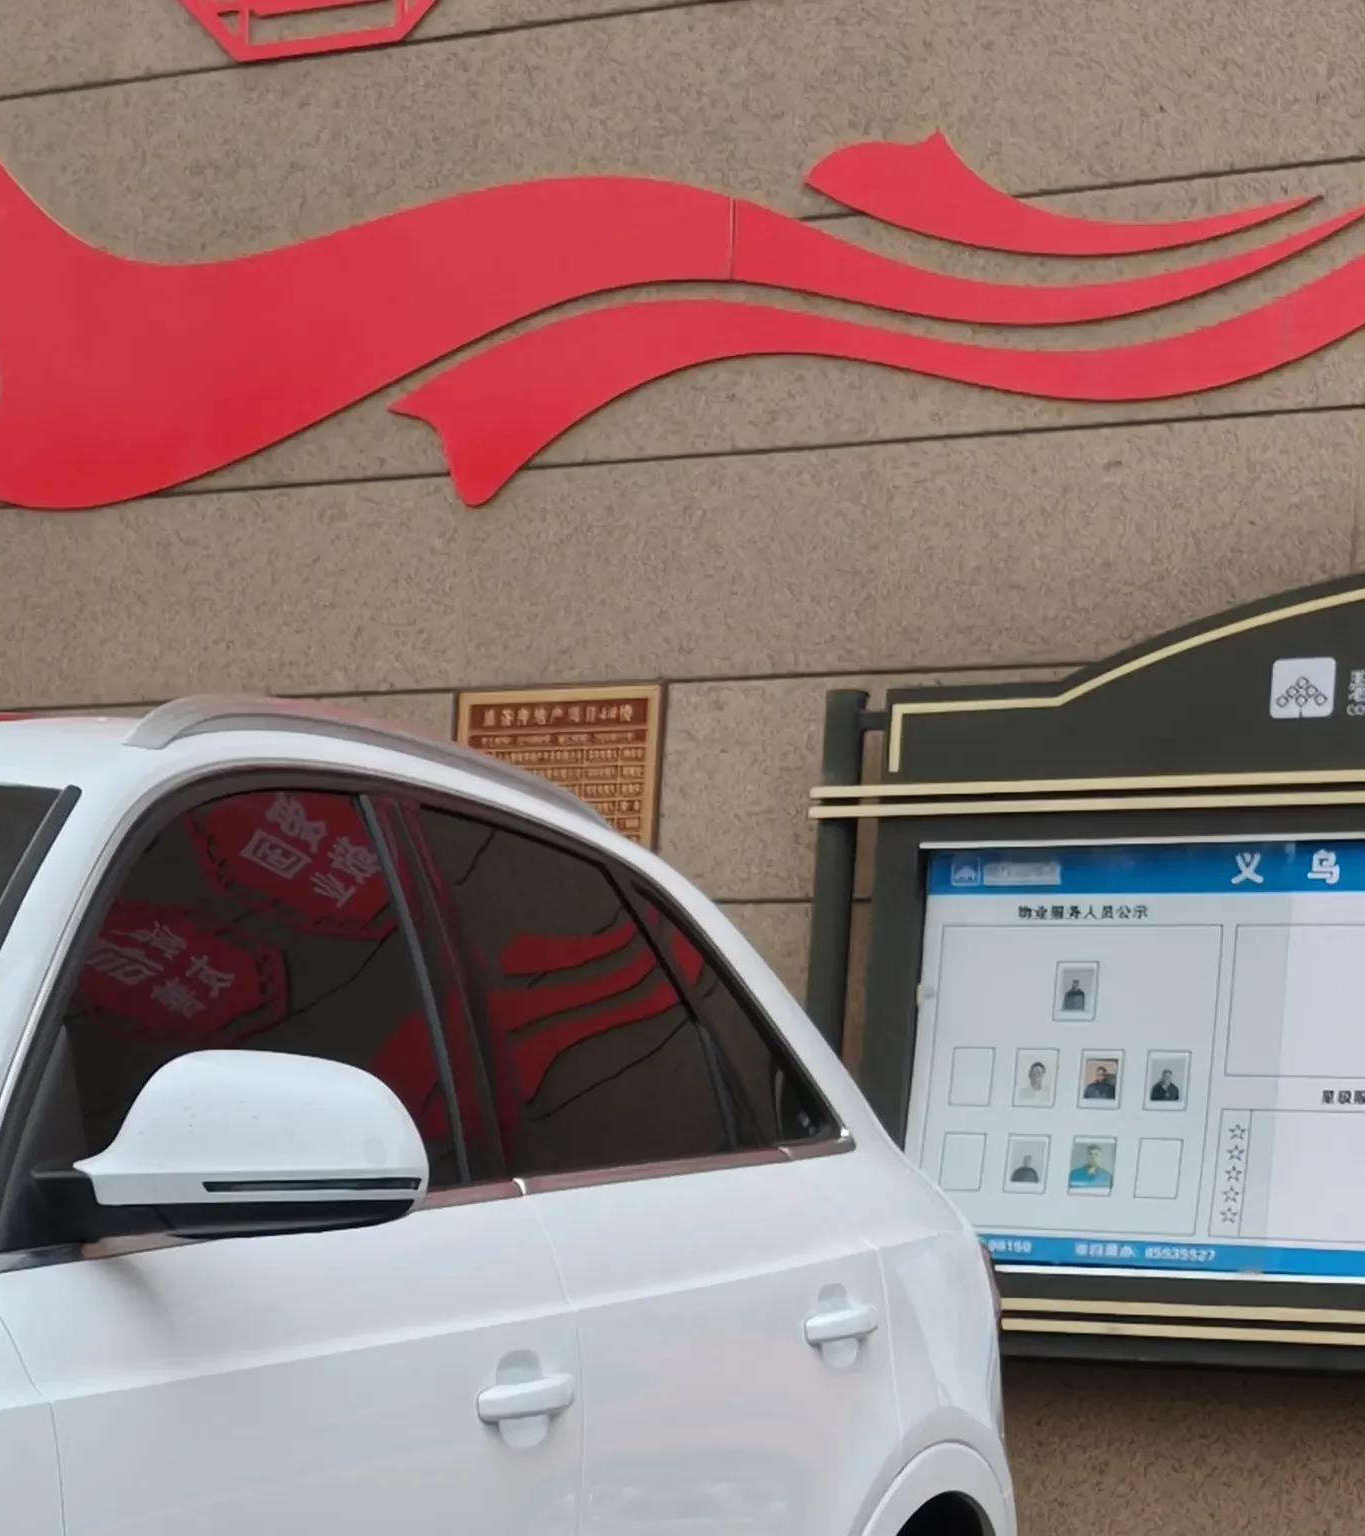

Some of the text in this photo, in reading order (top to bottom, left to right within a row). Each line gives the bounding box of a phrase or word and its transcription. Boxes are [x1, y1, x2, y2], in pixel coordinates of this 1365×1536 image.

[1018, 905, 1149, 920] 物业服务人员公示
